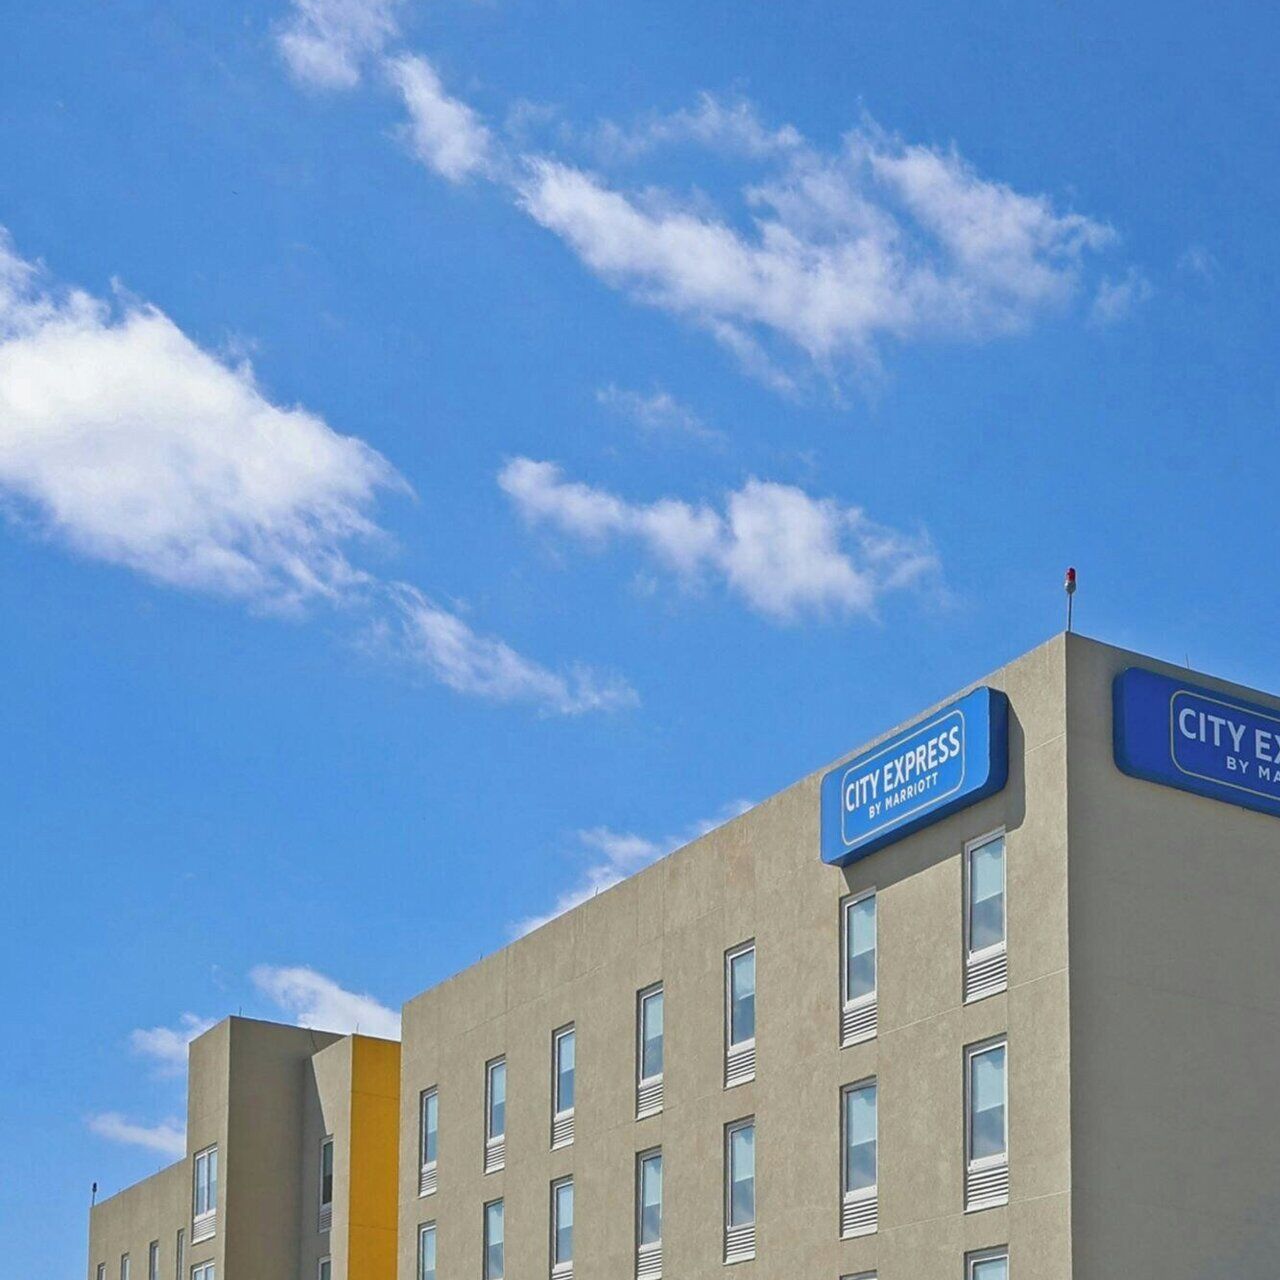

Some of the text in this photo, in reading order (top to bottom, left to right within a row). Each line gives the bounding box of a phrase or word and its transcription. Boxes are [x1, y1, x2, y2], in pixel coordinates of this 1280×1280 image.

[1178, 708, 1246, 753] CITY
[846, 725, 960, 811] CITY EXPRESS
[1226, 756, 1249, 774] BY
[869, 772, 938, 819] BY MARRIOTT
